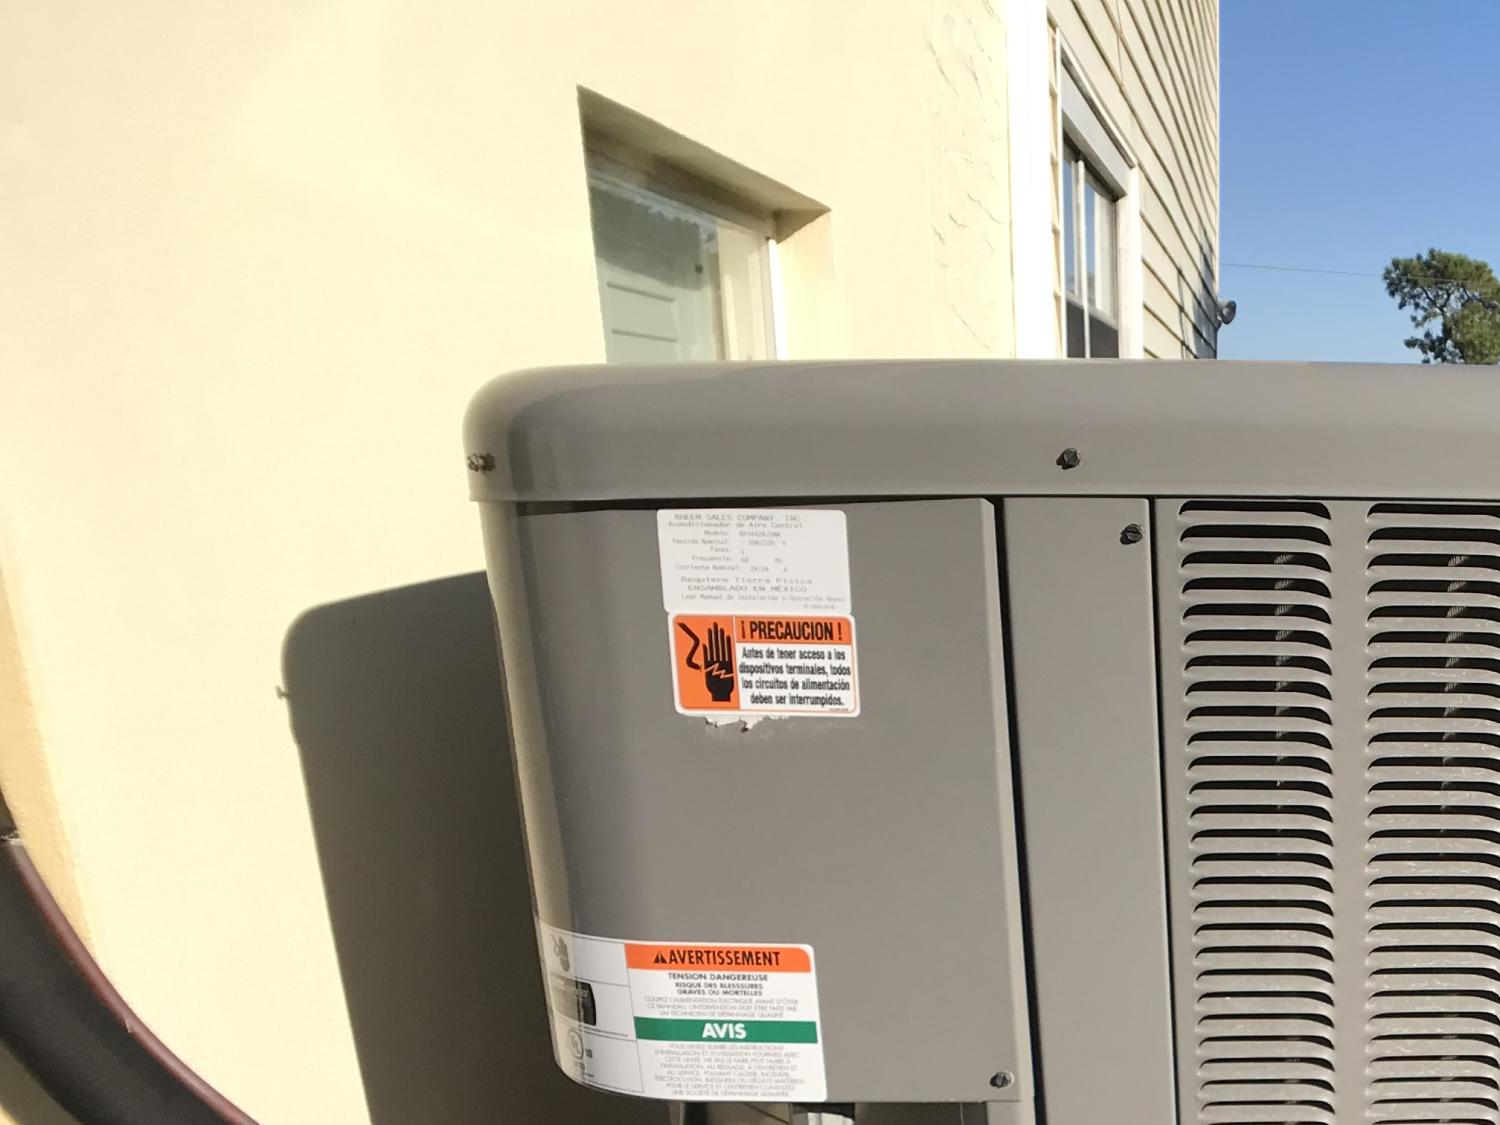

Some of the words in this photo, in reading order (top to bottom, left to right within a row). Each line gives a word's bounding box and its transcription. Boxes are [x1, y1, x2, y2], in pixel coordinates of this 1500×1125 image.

[750, 620, 834, 641] PRECAUCION
[837, 622, 843, 641] !
[742, 647, 763, 659] Antes
[766, 647, 774, 659] de
[777, 647, 796, 659] tener
[799, 649, 826, 660] acceso
[828, 650, 833, 660] a
[834, 648, 846, 660] los
[739, 661, 784, 676] dispositivos
[786, 662, 828, 677] terminales,
[831, 663, 851, 676] todos
[742, 678, 753, 689] los
[756, 678, 788, 690] circuitos
[791, 678, 799, 690] de
[802, 678, 850, 691] alimentación
[751, 692, 773, 704] deben
[776, 694, 787, 705] ser
[790, 693, 844, 707] interrumpidos.
[669, 949, 780, 966] AVERTISSEMENT
[668, 973, 707, 981] TENSION
[710, 973, 769, 981] DANGEREUSE
[702, 1023, 747, 1039] AVIS
